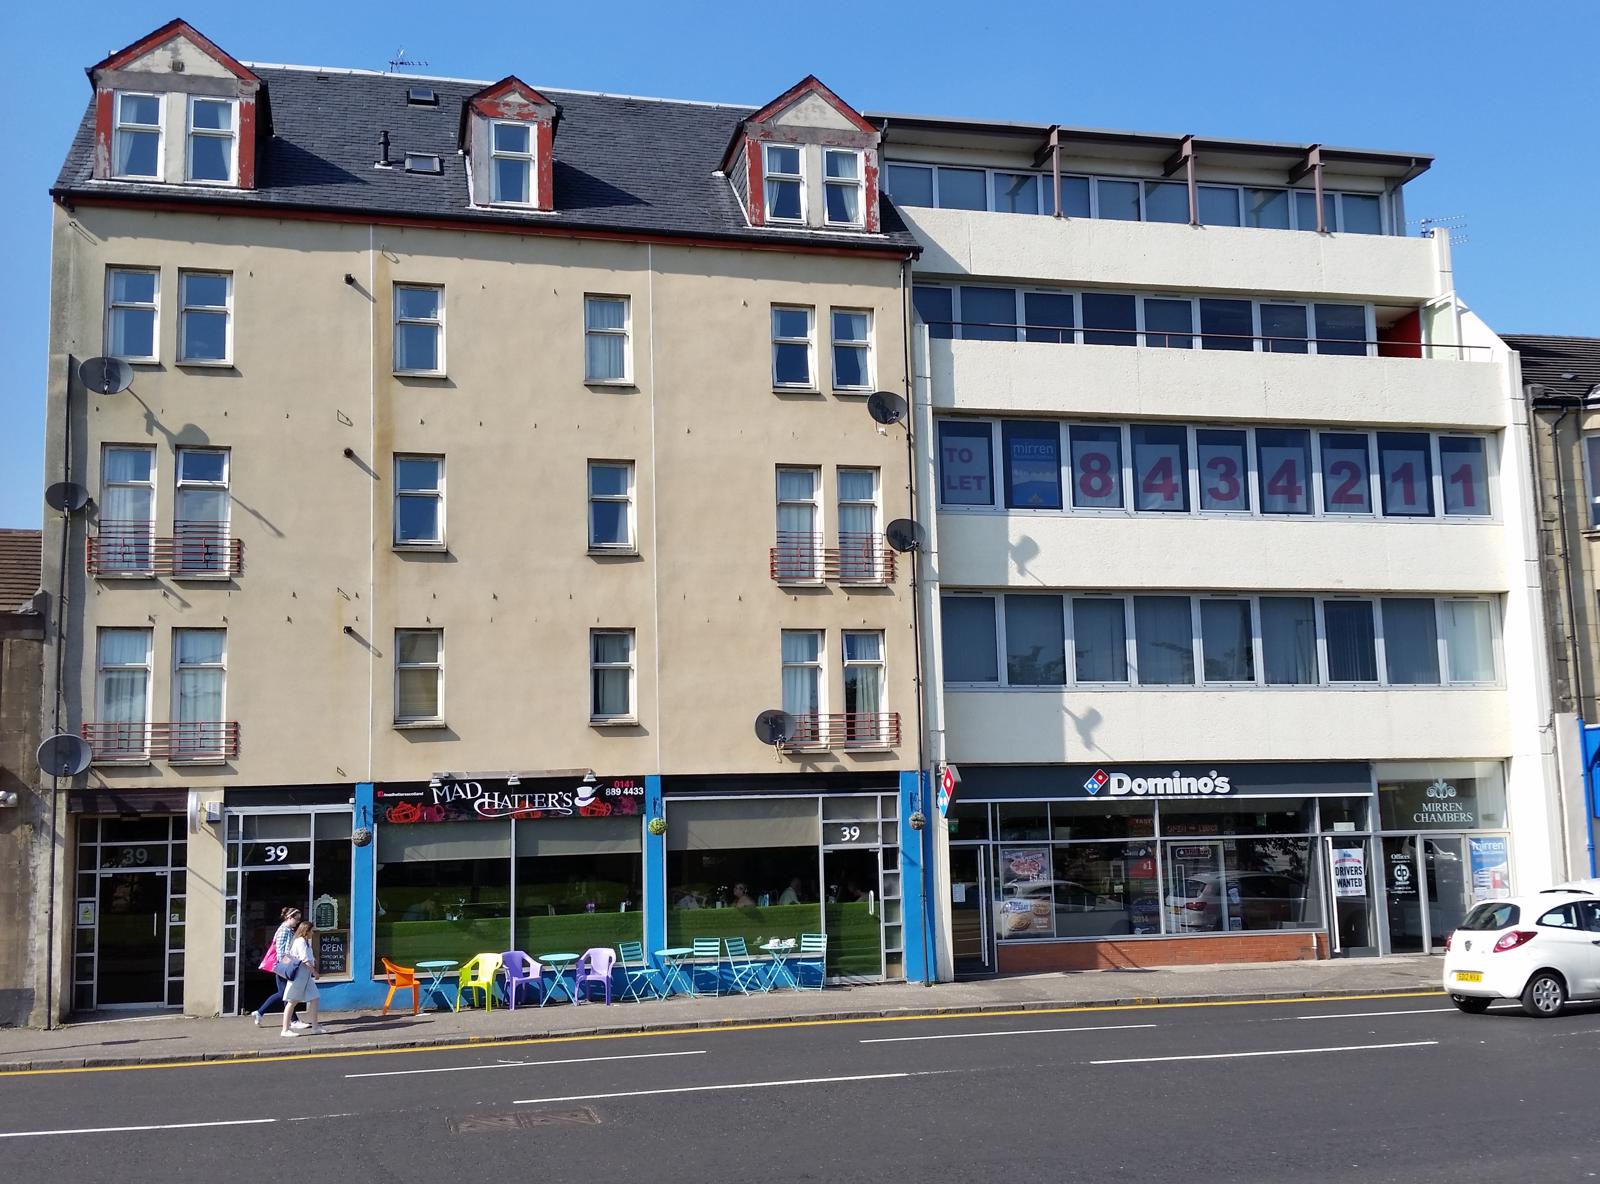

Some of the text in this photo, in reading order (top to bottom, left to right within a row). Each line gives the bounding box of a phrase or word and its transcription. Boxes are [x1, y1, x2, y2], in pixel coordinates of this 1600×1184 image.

[944, 447, 973, 463] TO
[1013, 442, 1054, 455] mirren
[946, 475, 986, 491] LET
[614, 780, 634, 788] 0141
[1109, 769, 1231, 795] Domino's
[431, 781, 573, 814] MAD HATTER'S
[605, 786, 644, 796] 889 4433
[1422, 802, 1463, 812] MIRREN
[1413, 812, 1474, 823] CHAMBERS
[841, 826, 860, 842] 39
[122, 847, 148, 865] 39
[264, 845, 288, 862] 39
[1335, 865, 1363, 876] DRIVERS
[1336, 877, 1363, 888] WANTED
[321, 943, 343, 952] OPEN
